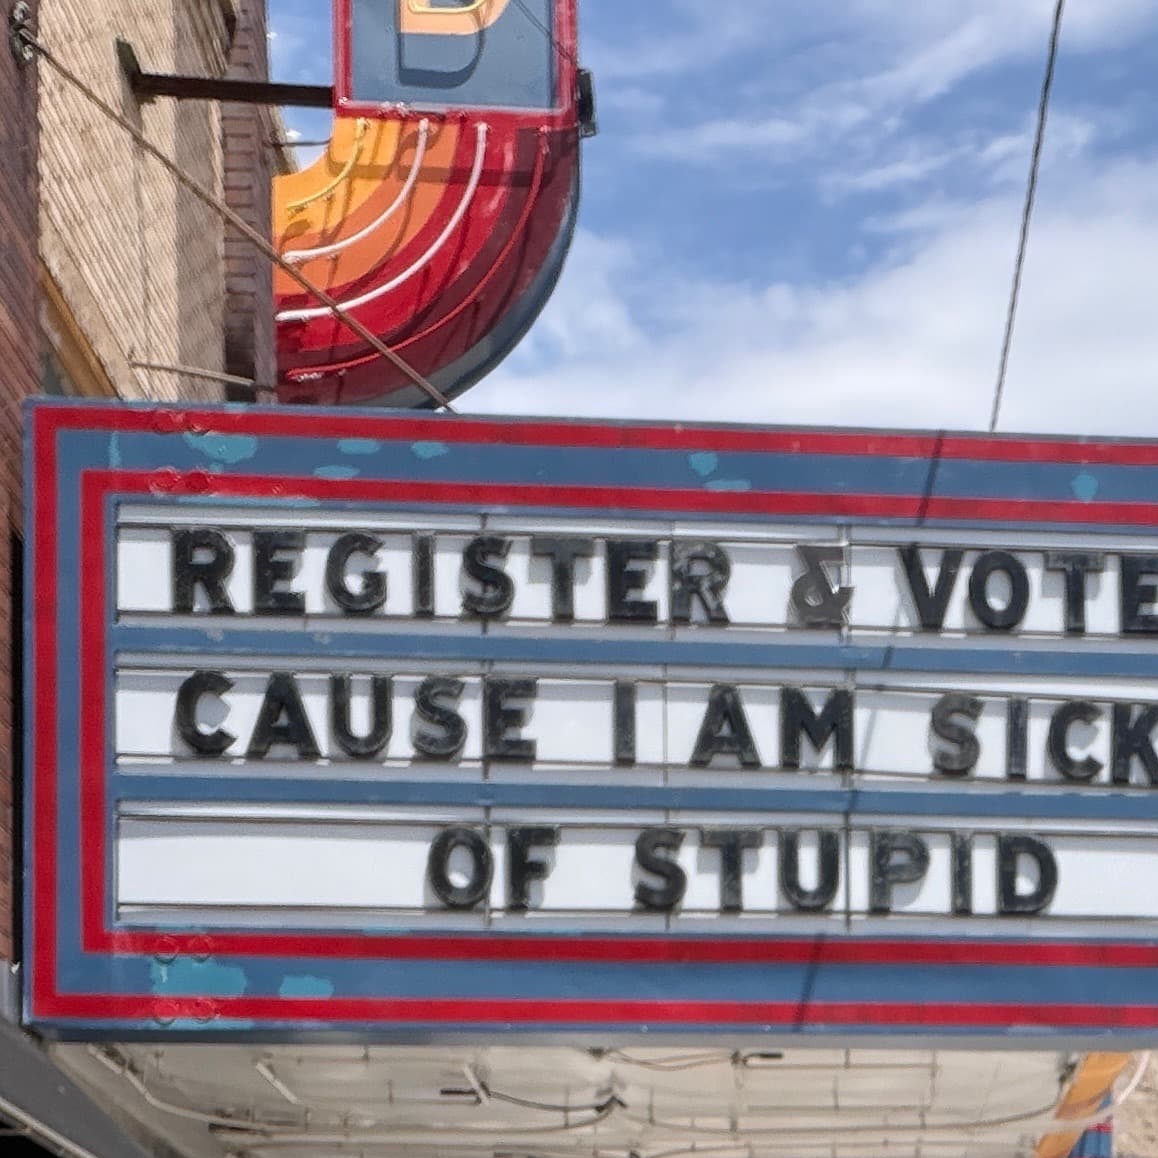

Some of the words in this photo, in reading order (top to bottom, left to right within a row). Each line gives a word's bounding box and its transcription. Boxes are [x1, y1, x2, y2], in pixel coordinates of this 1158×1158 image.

[171, 528, 731, 625] REGISTER
[788, 545, 853, 630] &
[174, 670, 537, 763] CAUSE
[613, 680, 636, 767] I
[690, 685, 854, 770] AM
[426, 826, 561, 911] OF
[633, 827, 1059, 915] STUPID
